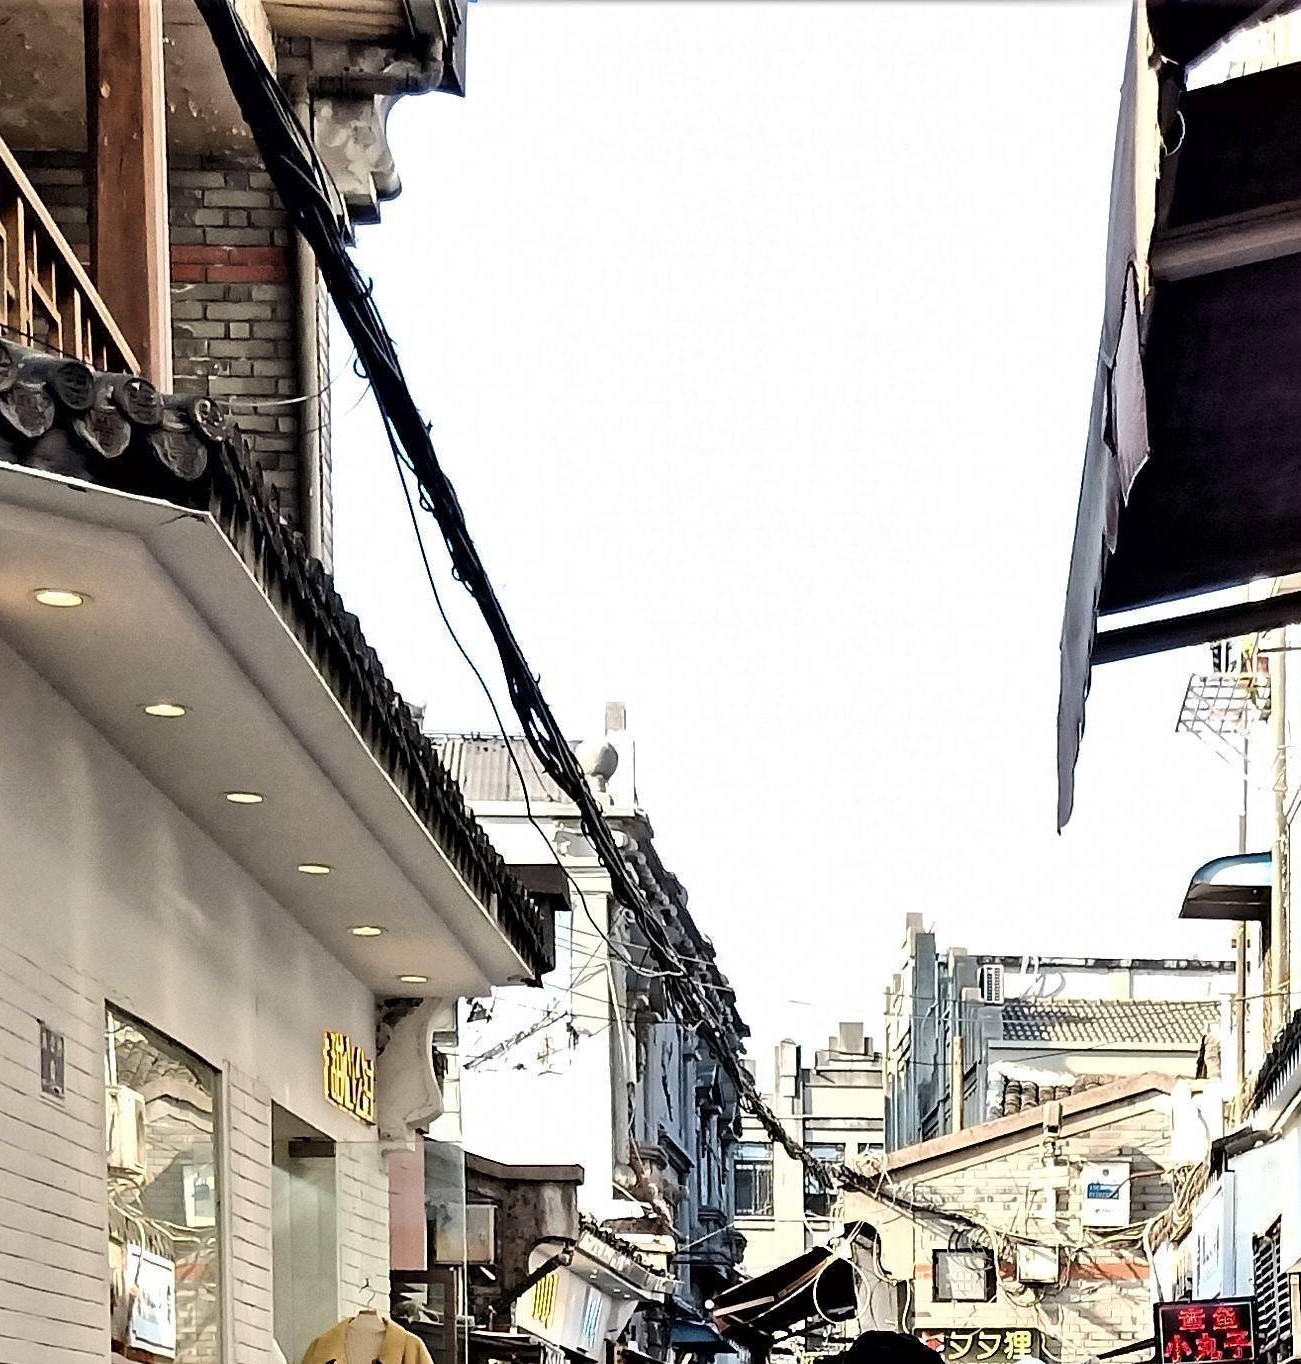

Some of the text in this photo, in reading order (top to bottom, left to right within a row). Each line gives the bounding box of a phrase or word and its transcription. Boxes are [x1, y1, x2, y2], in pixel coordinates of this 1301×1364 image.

[1177, 1306, 1239, 1332] 章鱼
[1164, 1330, 1253, 1364] 小丸子
